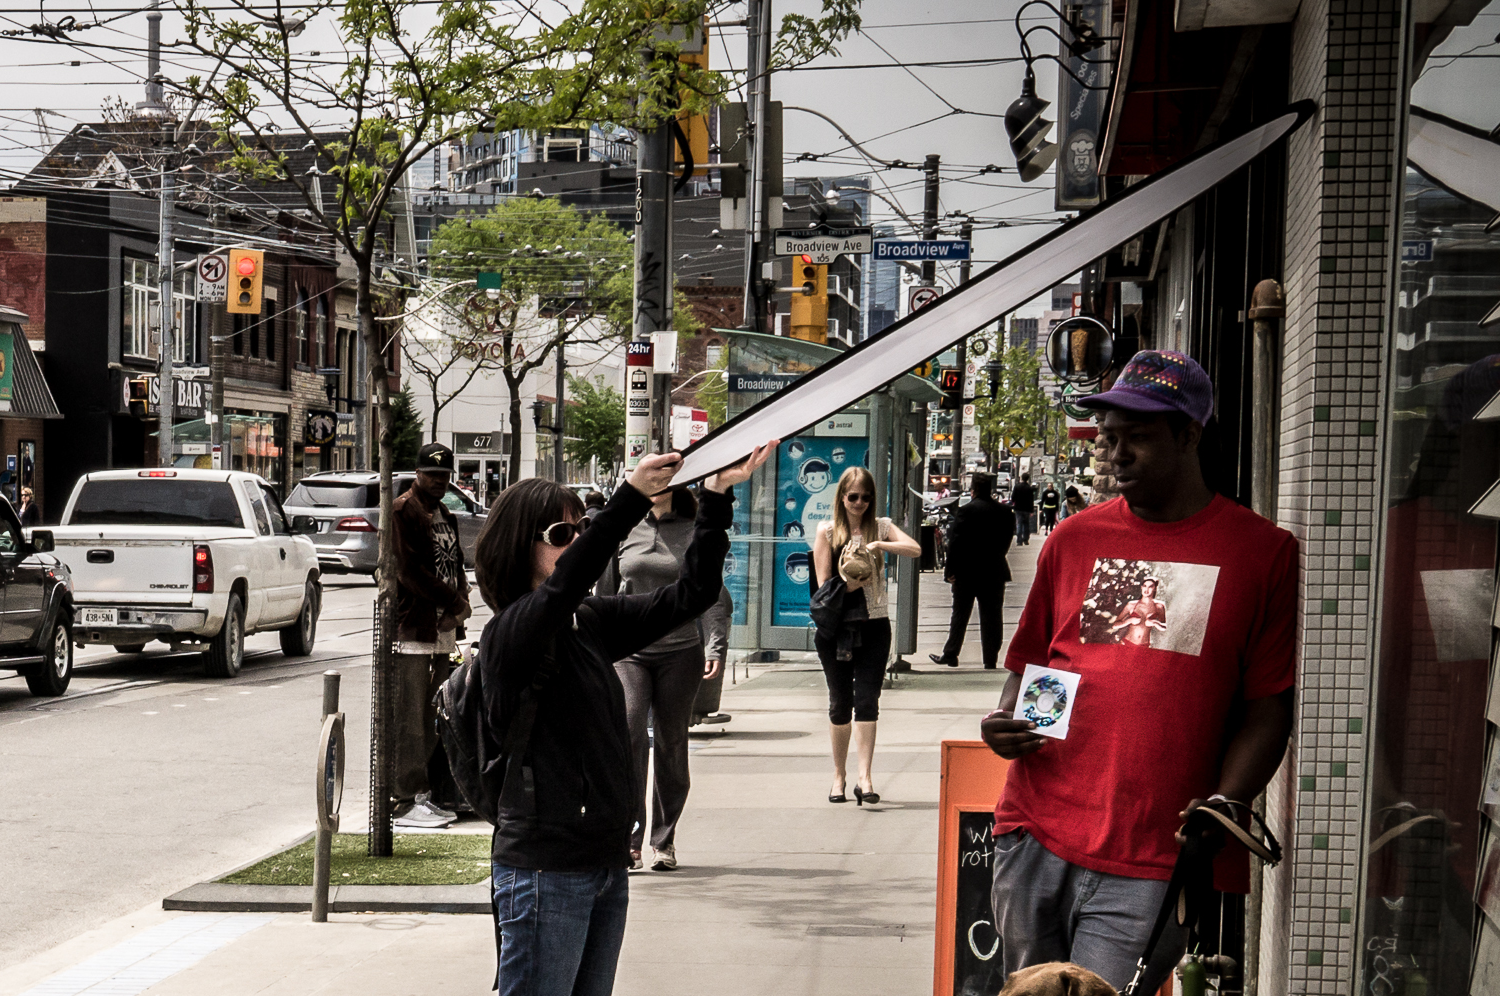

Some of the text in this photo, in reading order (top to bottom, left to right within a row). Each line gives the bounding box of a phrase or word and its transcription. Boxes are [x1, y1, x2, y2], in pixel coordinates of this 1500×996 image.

[786, 240, 862, 252] Broadview Ave
[878, 242, 965, 257] Broadview Ave
[628, 343, 651, 354] 24hr
[737, 378, 784, 390] Broadview
[177, 380, 202, 408] BAR
[473, 436, 492, 448] 677
